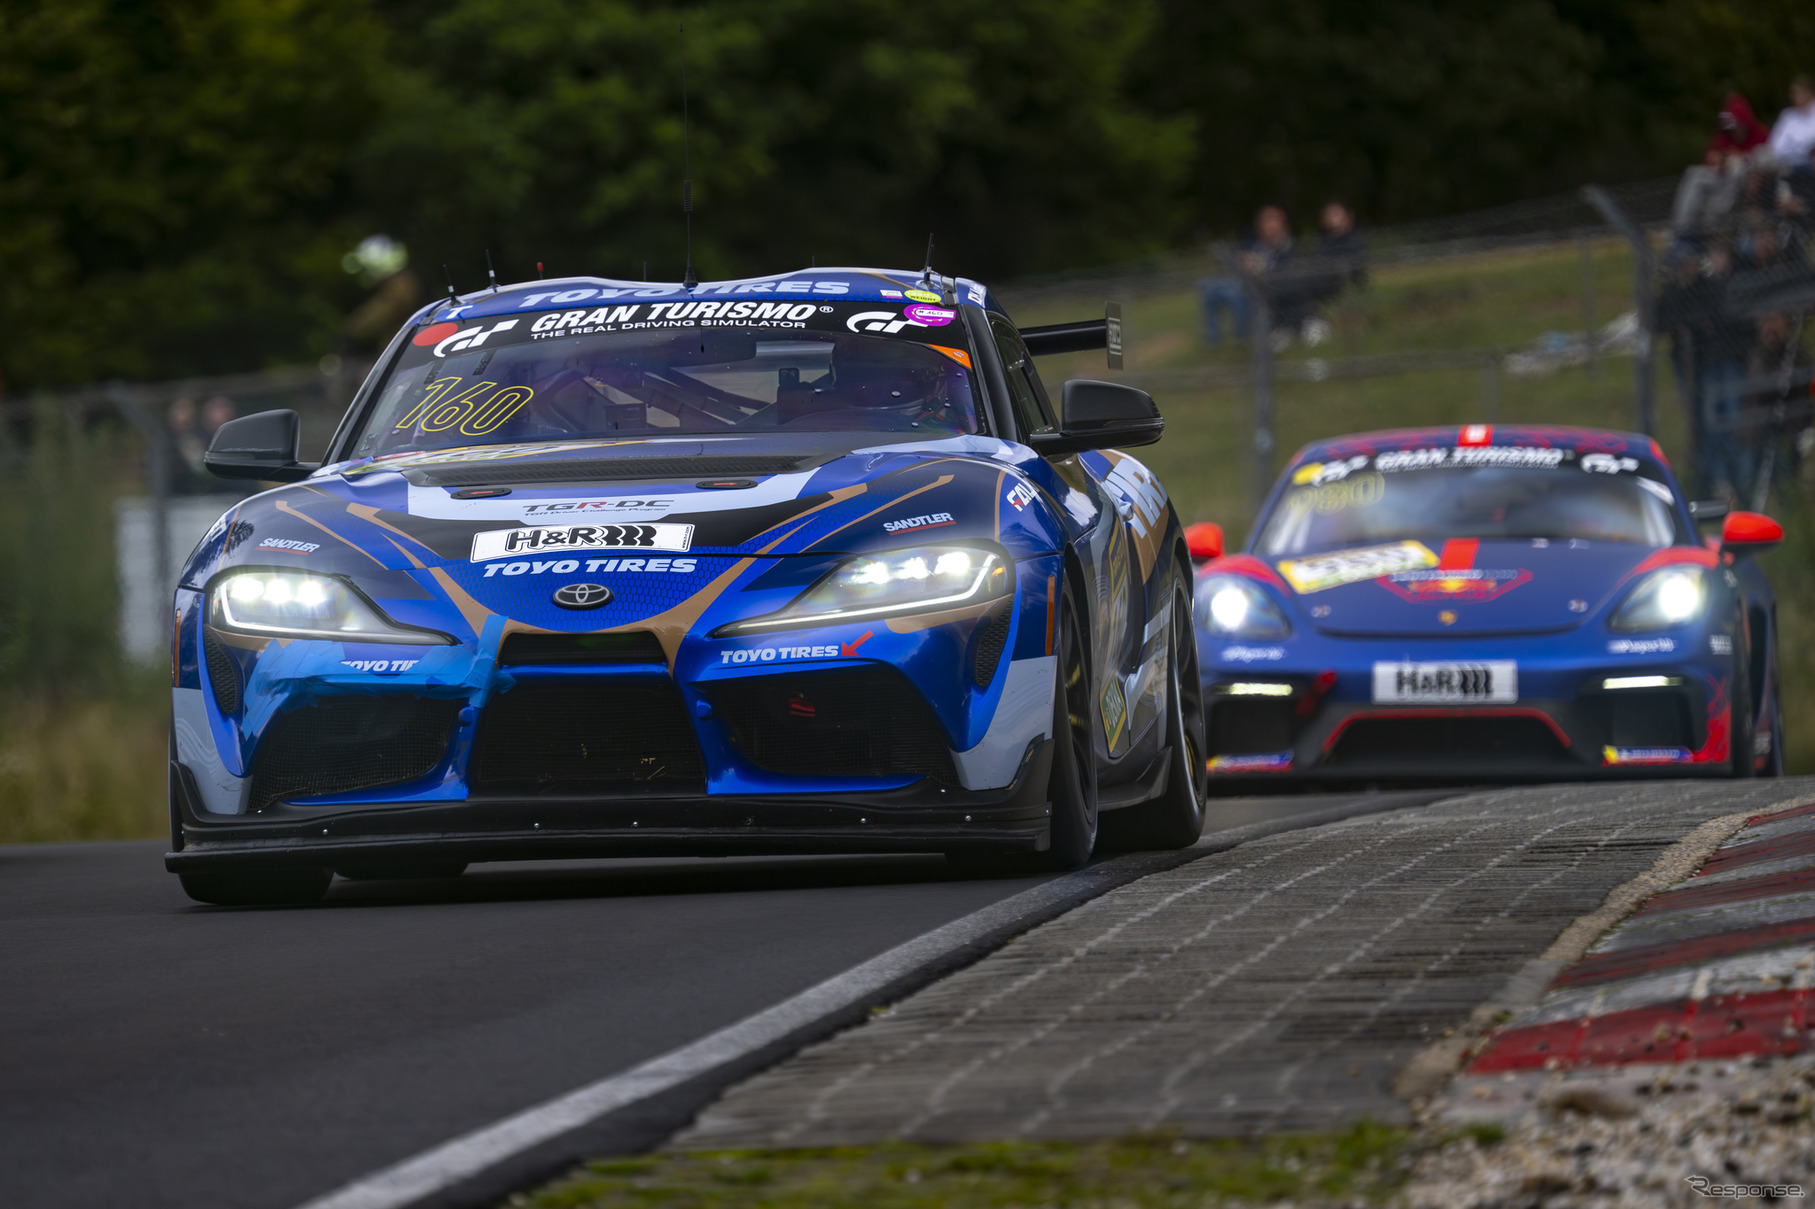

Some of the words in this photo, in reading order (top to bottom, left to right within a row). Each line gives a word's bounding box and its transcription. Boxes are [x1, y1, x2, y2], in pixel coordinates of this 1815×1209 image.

[518, 288, 681, 308] TOYO
[688, 280, 850, 295] TIRES
[530, 304, 641, 333] GRAN
[530, 329, 566, 340] THE
[570, 324, 617, 335] REAL
[621, 319, 695, 330] DRIVING
[700, 320, 806, 329] SIMULATOR
[395, 376, 534, 436] 160
[522, 499, 675, 513] TGR-DC
[883, 512, 954, 533] SANDTLER
[259, 537, 320, 553] SANDTLER
[483, 559, 580, 578] TOYO
[584, 558, 698, 574] TIRES
[720, 648, 776, 664] TOYO
[780, 645, 839, 659] TIRES
